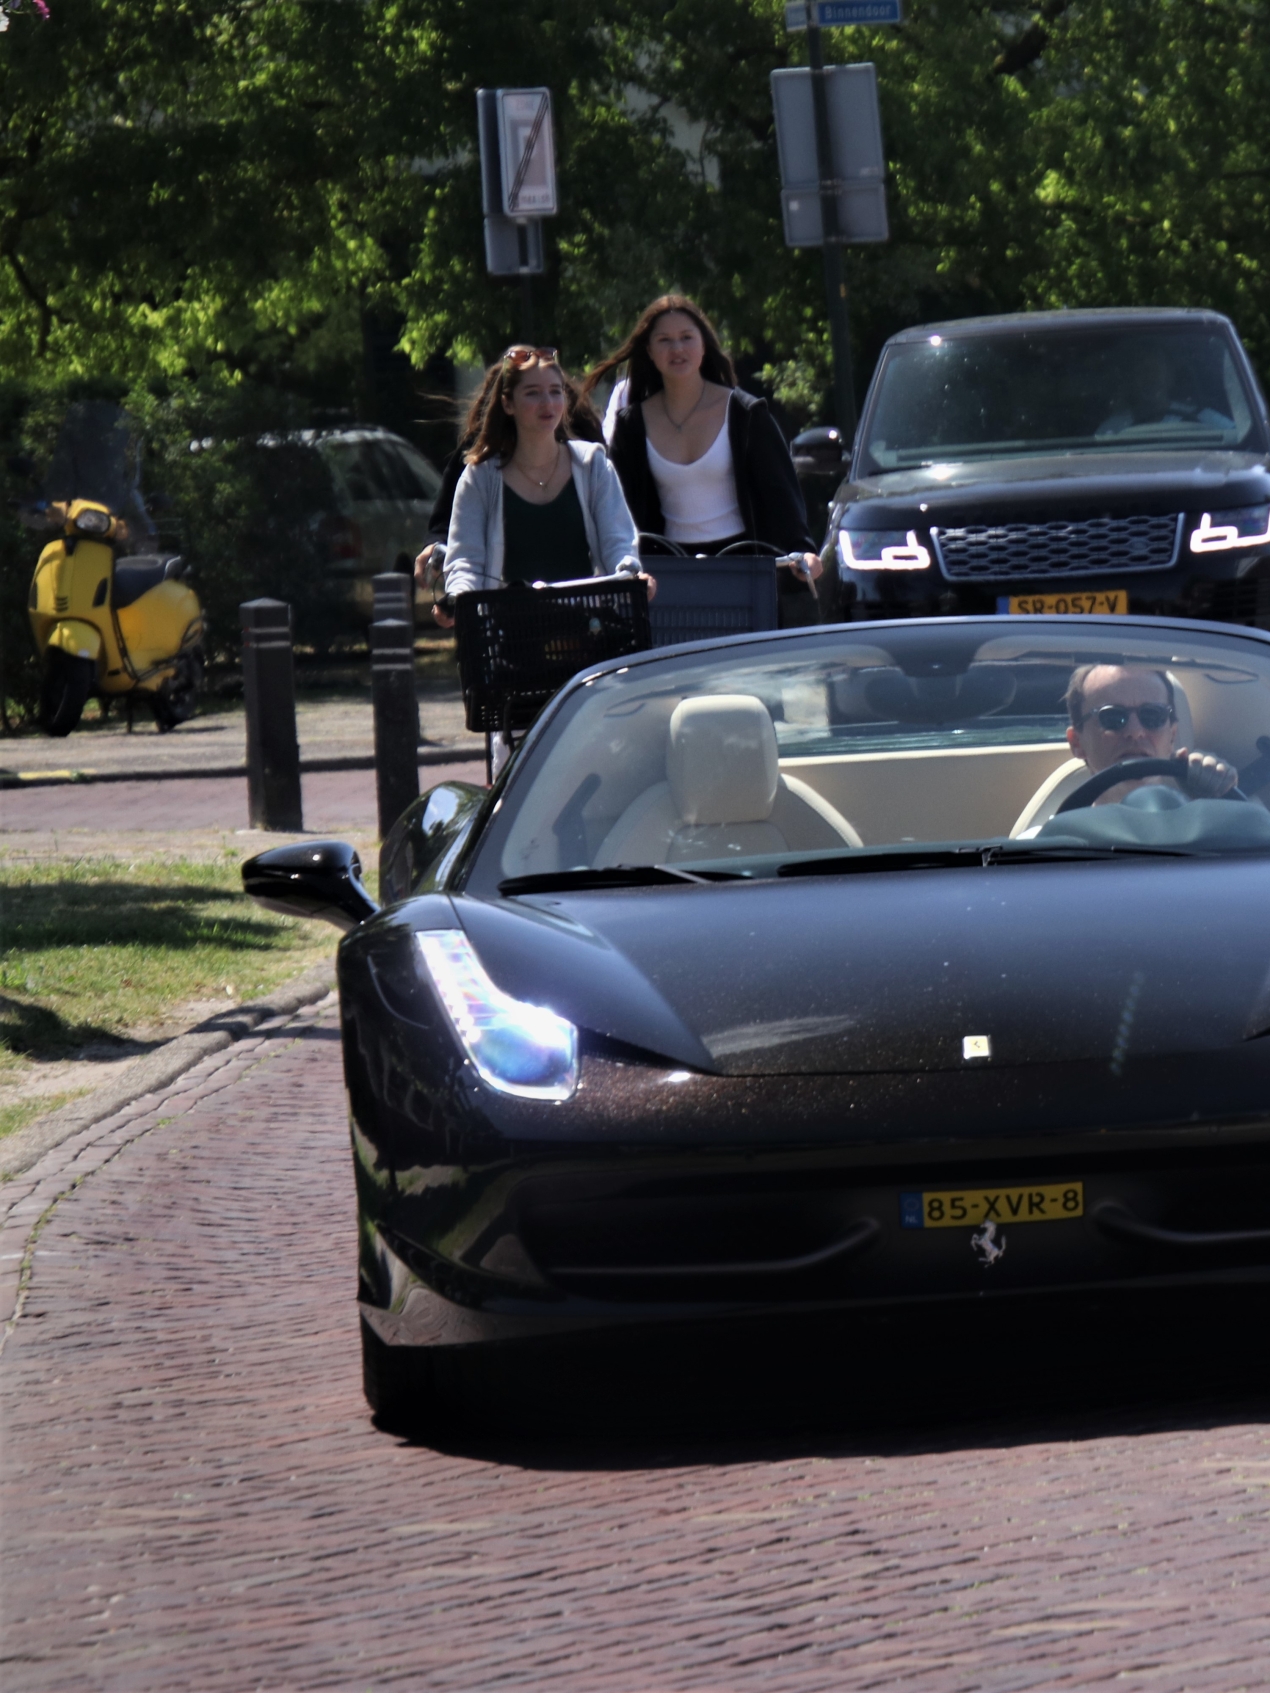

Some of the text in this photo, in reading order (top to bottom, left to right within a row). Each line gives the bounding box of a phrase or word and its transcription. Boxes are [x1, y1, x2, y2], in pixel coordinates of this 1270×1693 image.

[824, 4, 891, 20] Binnendoor
[1017, 594, 1119, 615] SR-057-V
[927, 1188, 1080, 1222] 85-XVR-8
[905, 1214, 919, 1224] NL
